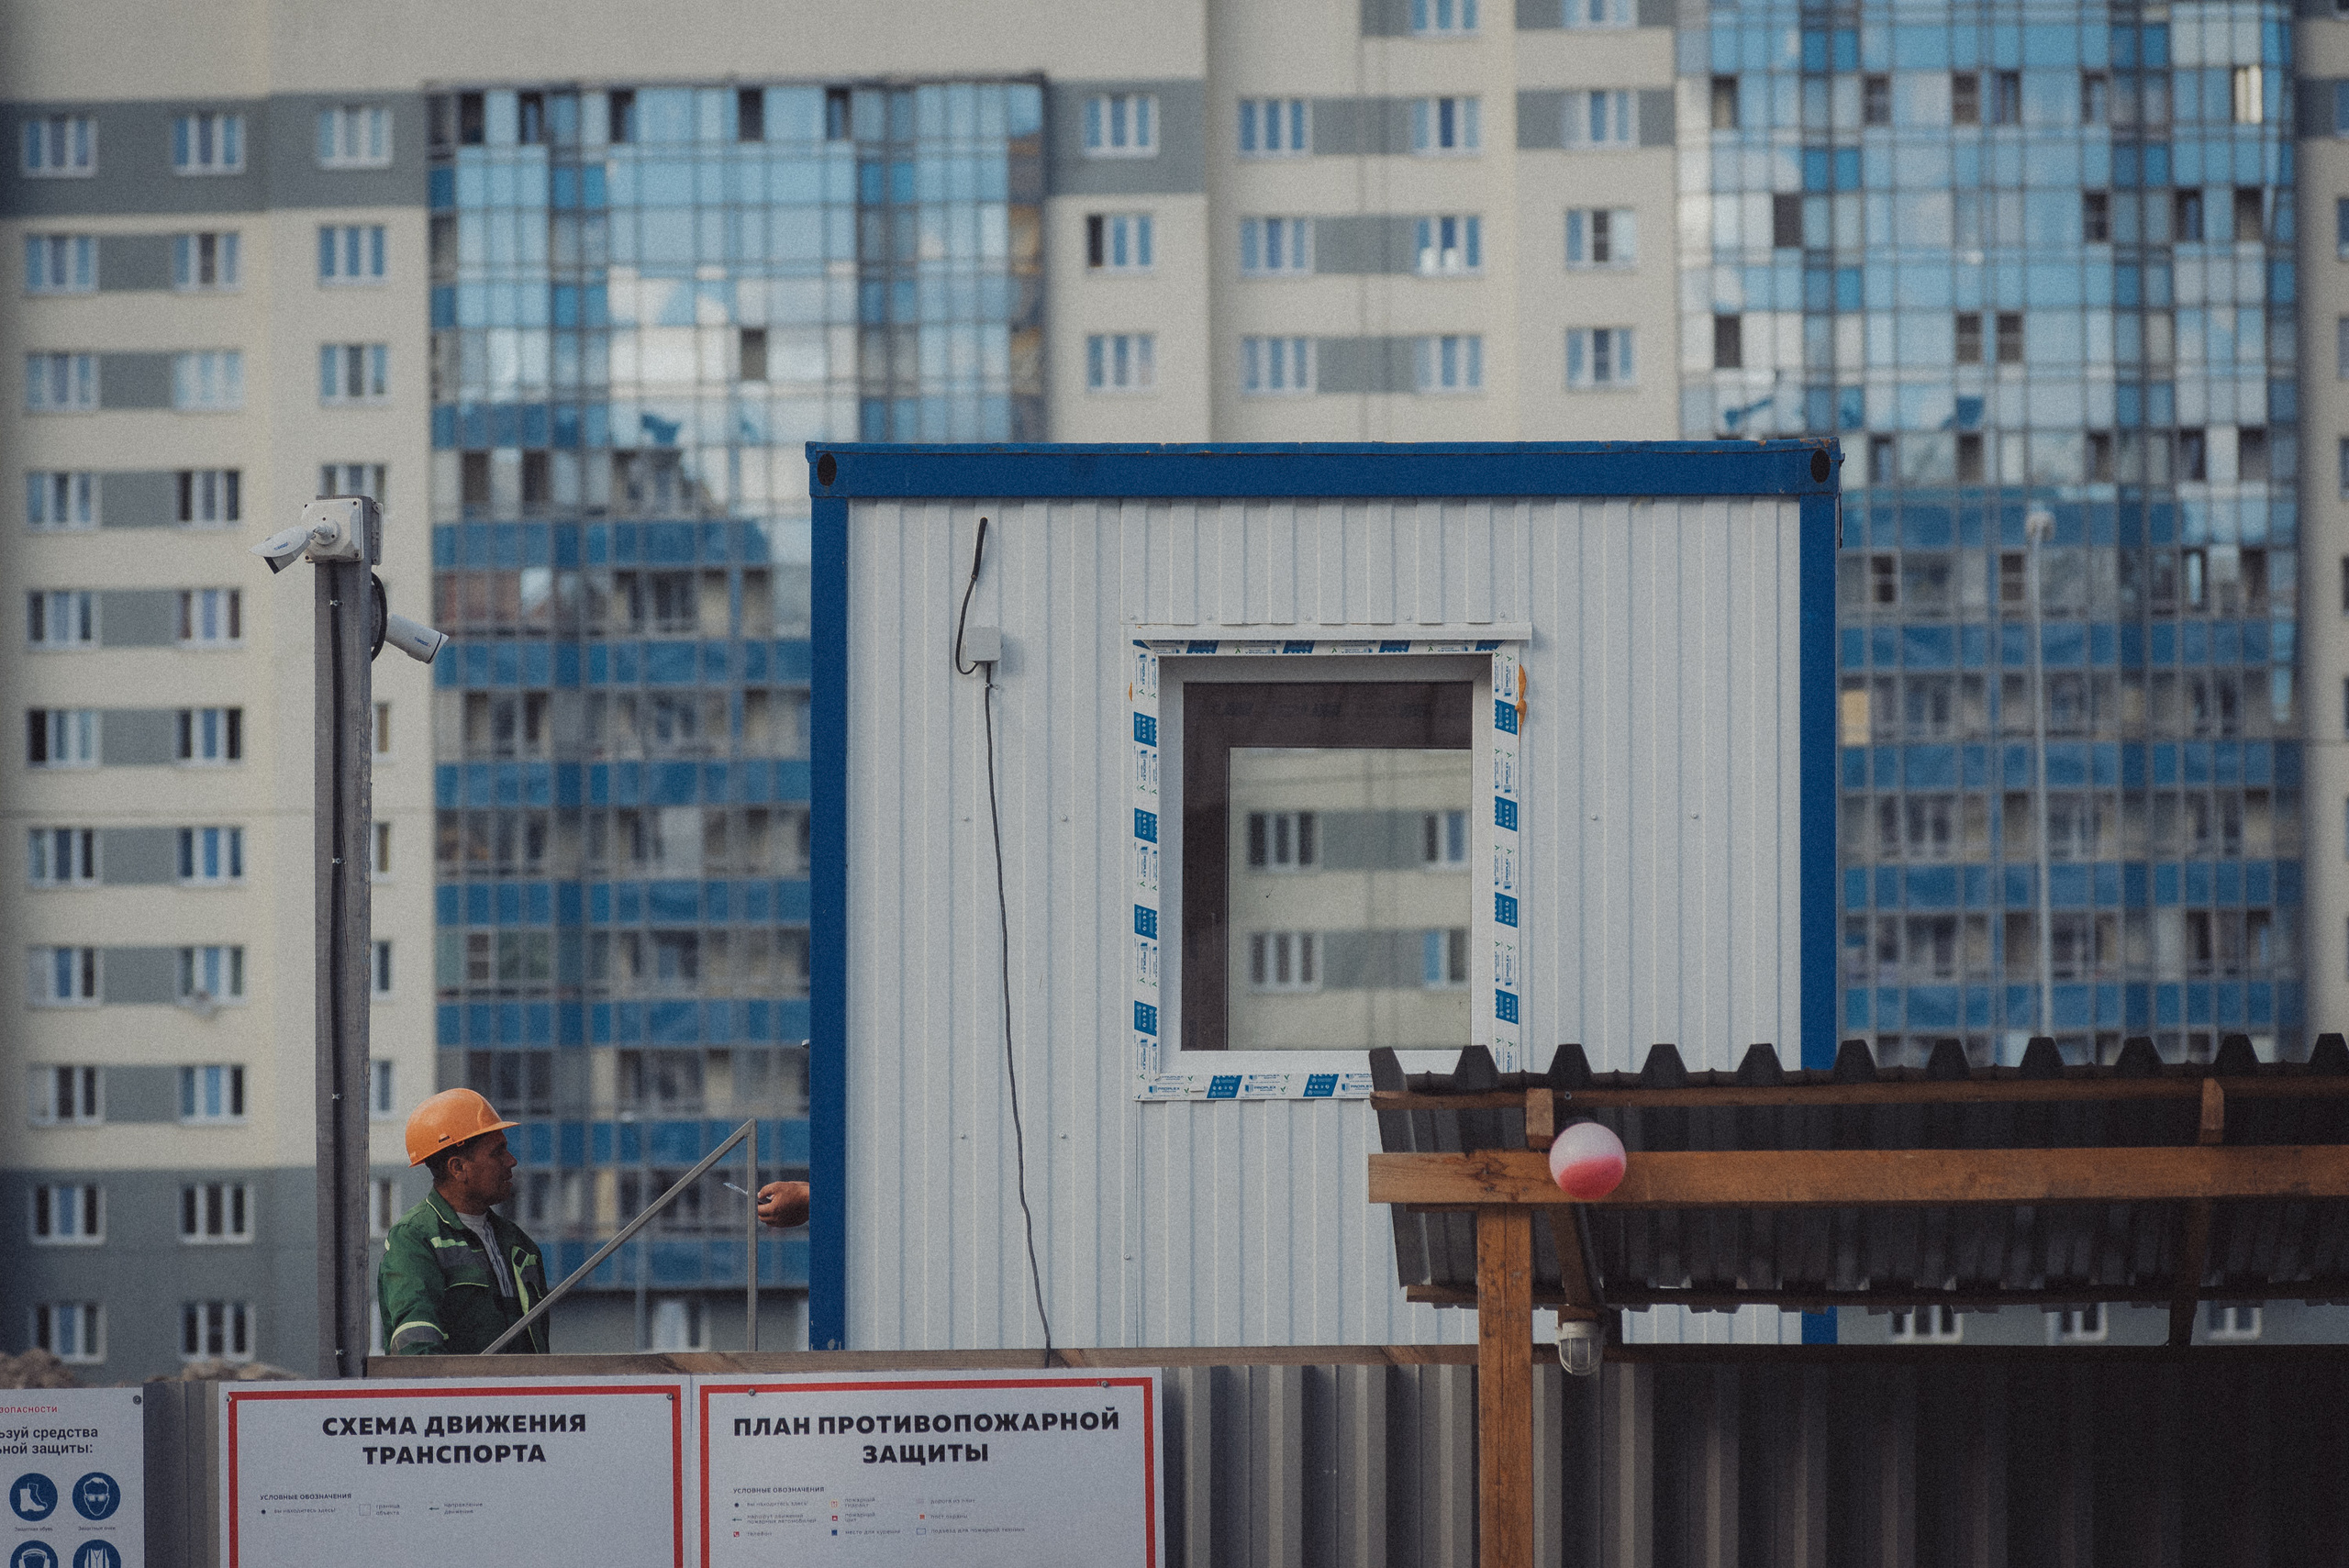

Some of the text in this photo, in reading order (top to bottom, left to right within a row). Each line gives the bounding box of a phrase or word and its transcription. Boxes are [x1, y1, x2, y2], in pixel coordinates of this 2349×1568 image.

[322, 1414, 586, 1438] СХЕМА ДВИЖЕНИЯ
[734, 1407, 1119, 1436] ПЛАН ПРОТИВОПОЖАРНОЙ
[33, 1429, 98, 1440] средства
[0, 1442, 93, 1455] ной защиты:
[362, 1444, 546, 1464] ТРАНСПОРТА
[863, 1443, 989, 1465] ЗАЩИТЫ
